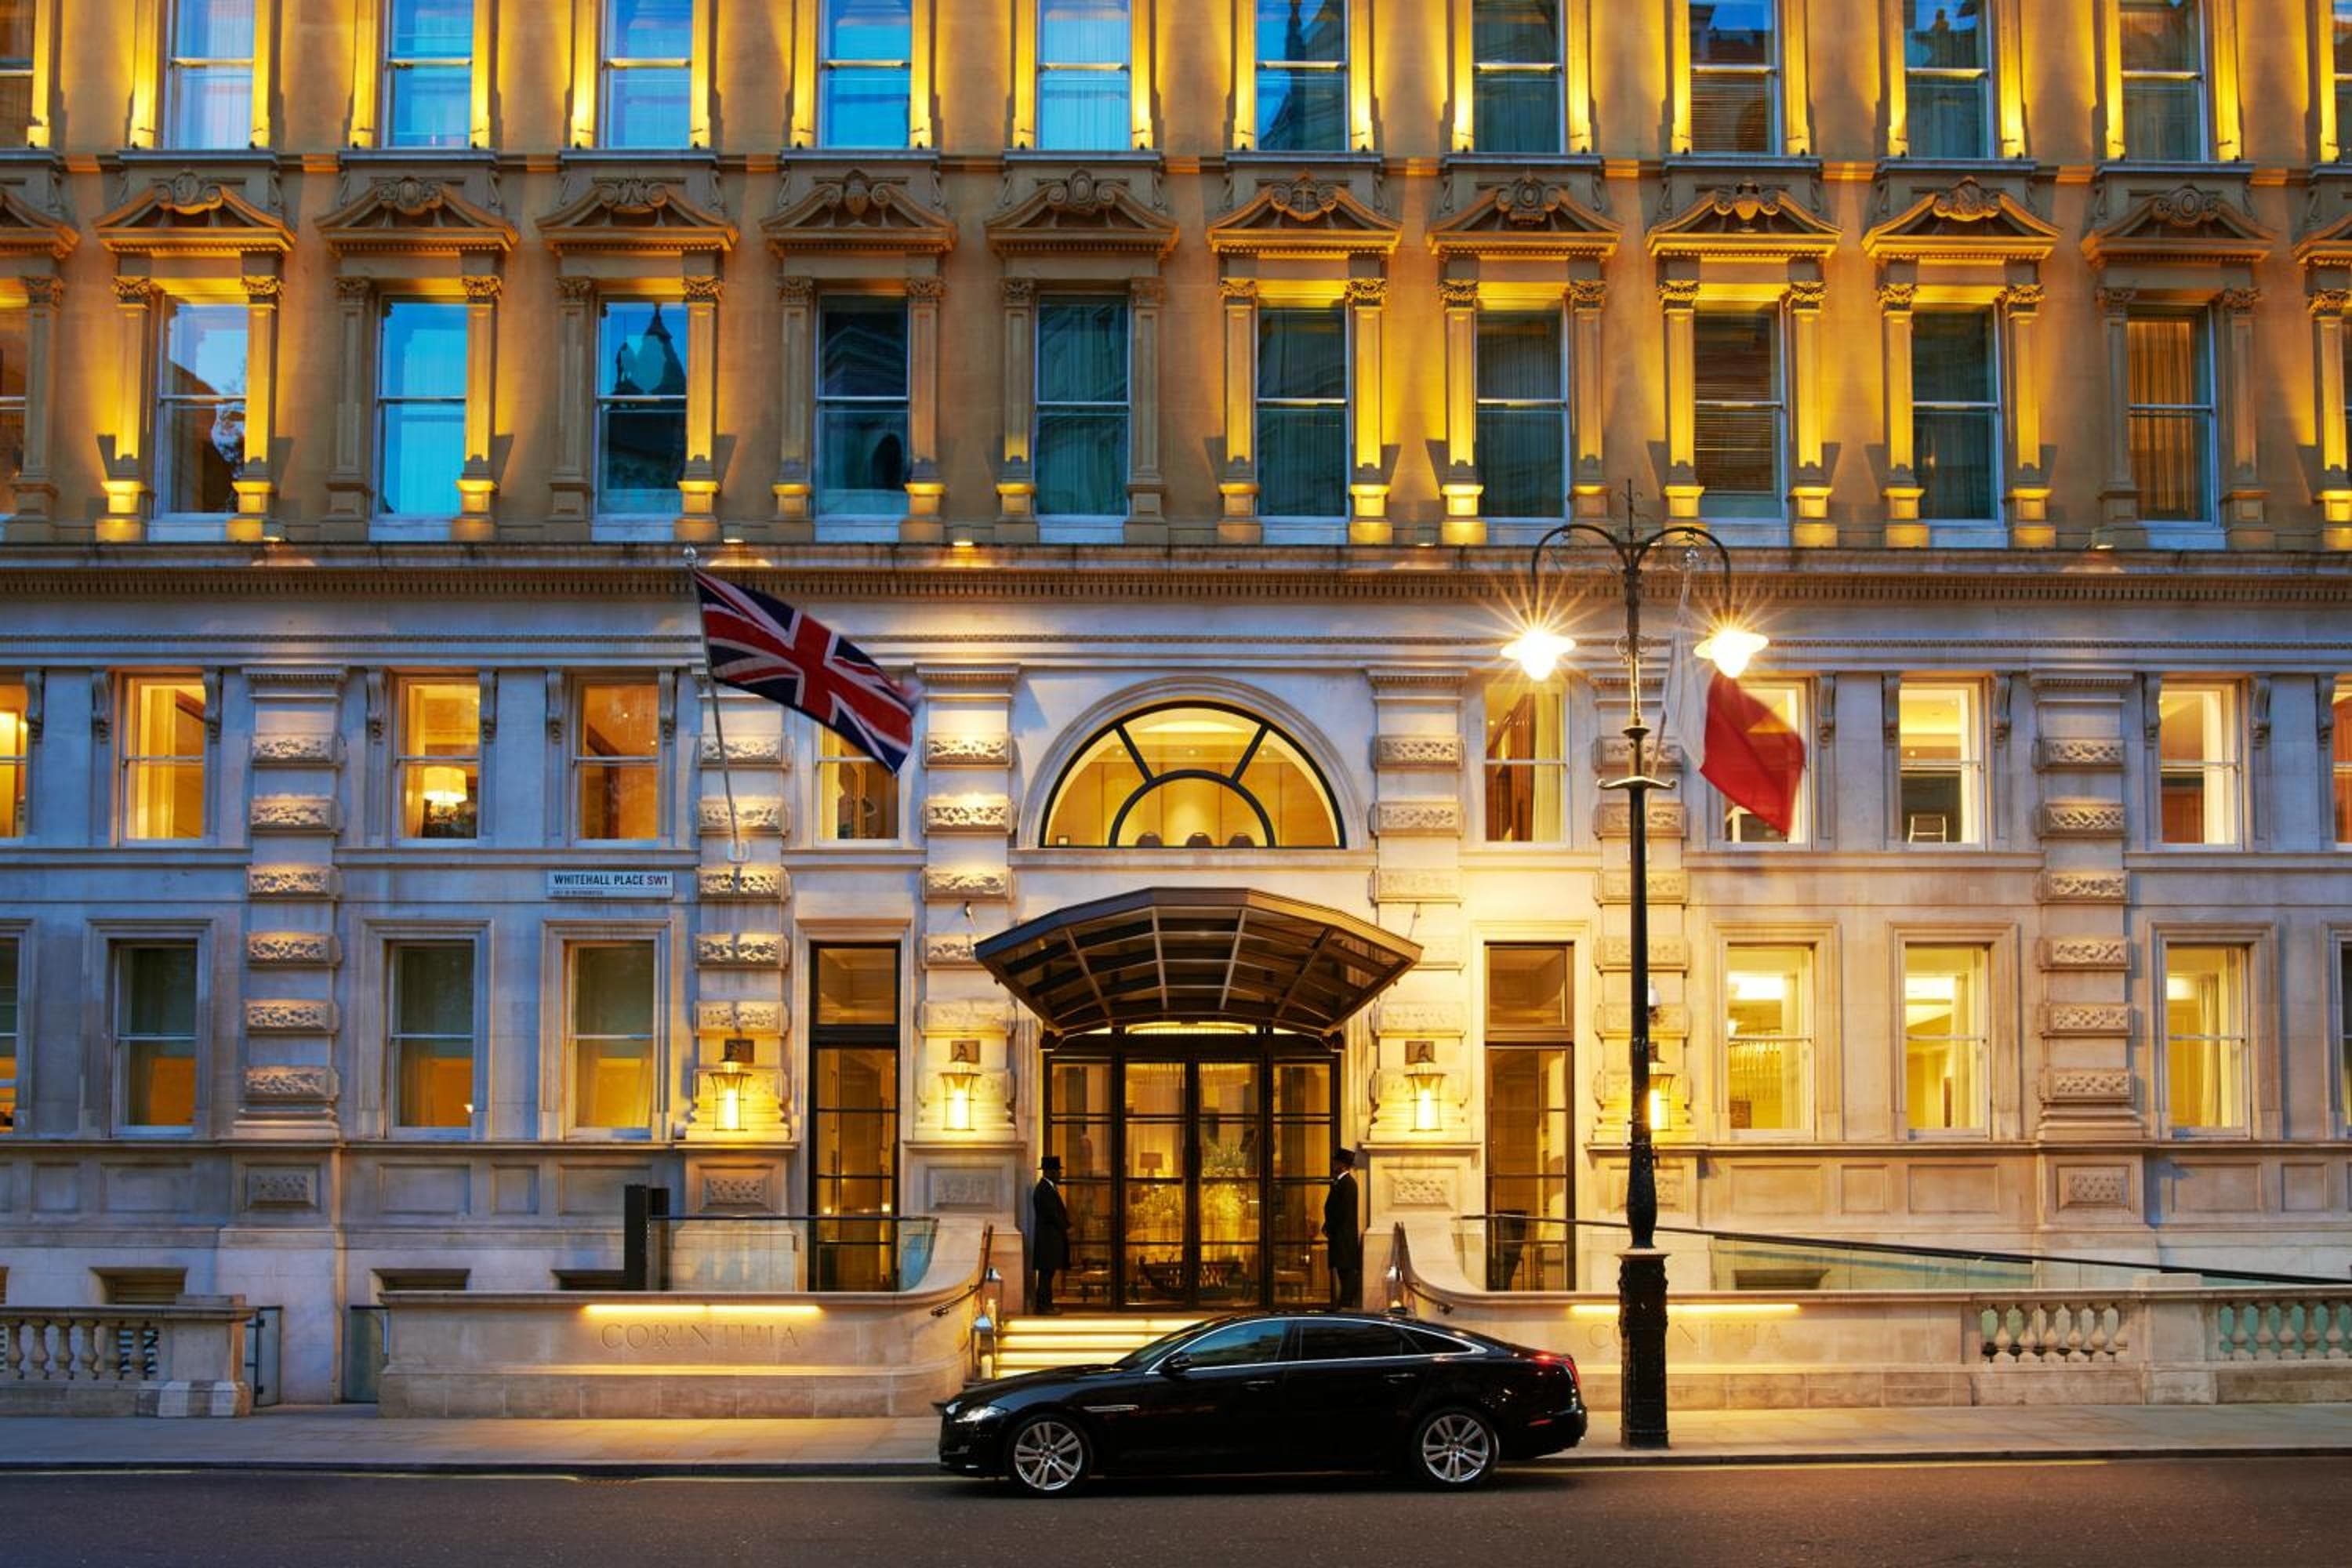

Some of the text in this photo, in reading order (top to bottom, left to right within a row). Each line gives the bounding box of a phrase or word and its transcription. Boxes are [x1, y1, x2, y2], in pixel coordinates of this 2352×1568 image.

[554, 874, 667, 885] WHITEHALL PLACE SW1
[601, 1323, 800, 1348] CORINTHIA
